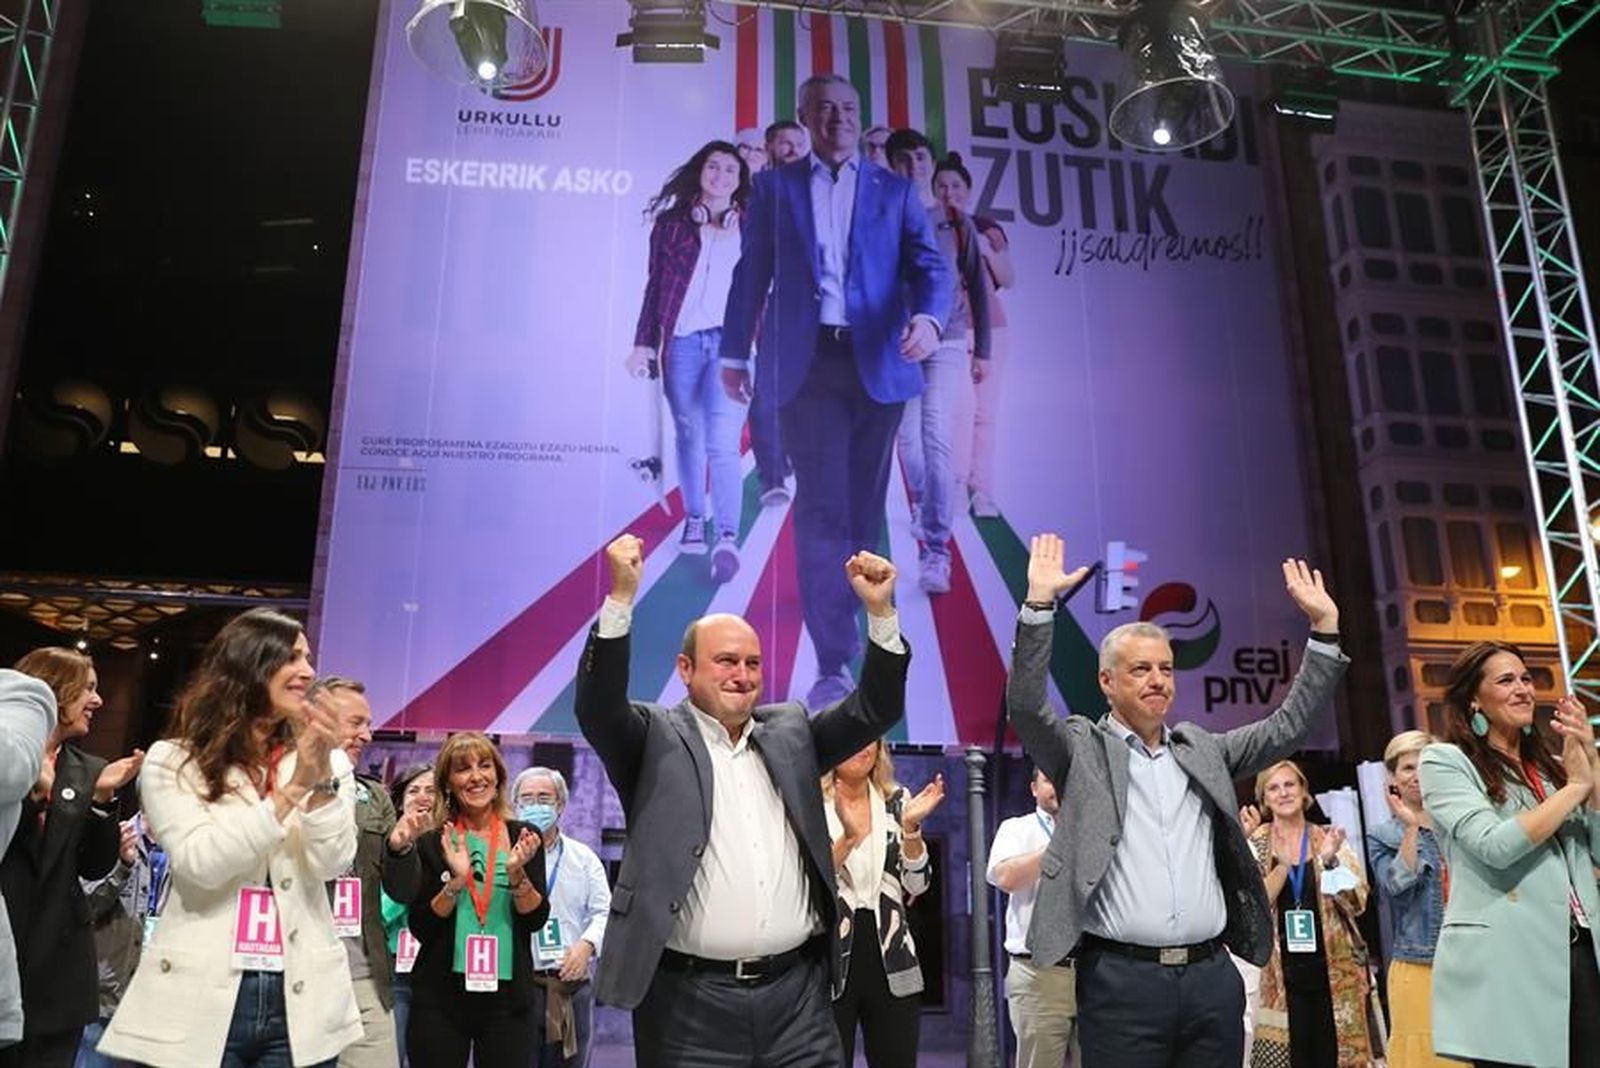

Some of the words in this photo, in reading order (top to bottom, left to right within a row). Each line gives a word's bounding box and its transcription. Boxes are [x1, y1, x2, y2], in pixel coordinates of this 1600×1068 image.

[458, 109, 561, 127] URKULLU
[967, 67, 1259, 165] EUSDI
[405, 157, 546, 192] ESKERRIK
[553, 166, 633, 196] ASKO
[970, 146, 1179, 236] ZUTIK
[360, 447, 407, 457] CONOCE
[442, 451, 496, 461] NUESTRO
[395, 437, 483, 449] PROPOSAMENA
[1234, 640, 1291, 684] eaj
[1204, 676, 1275, 712] pnv
[335, 879, 353, 917] H
[247, 893, 278, 942] H
[544, 920, 556, 946] E
[1294, 914, 1308, 938] E
[472, 940, 491, 972] H
